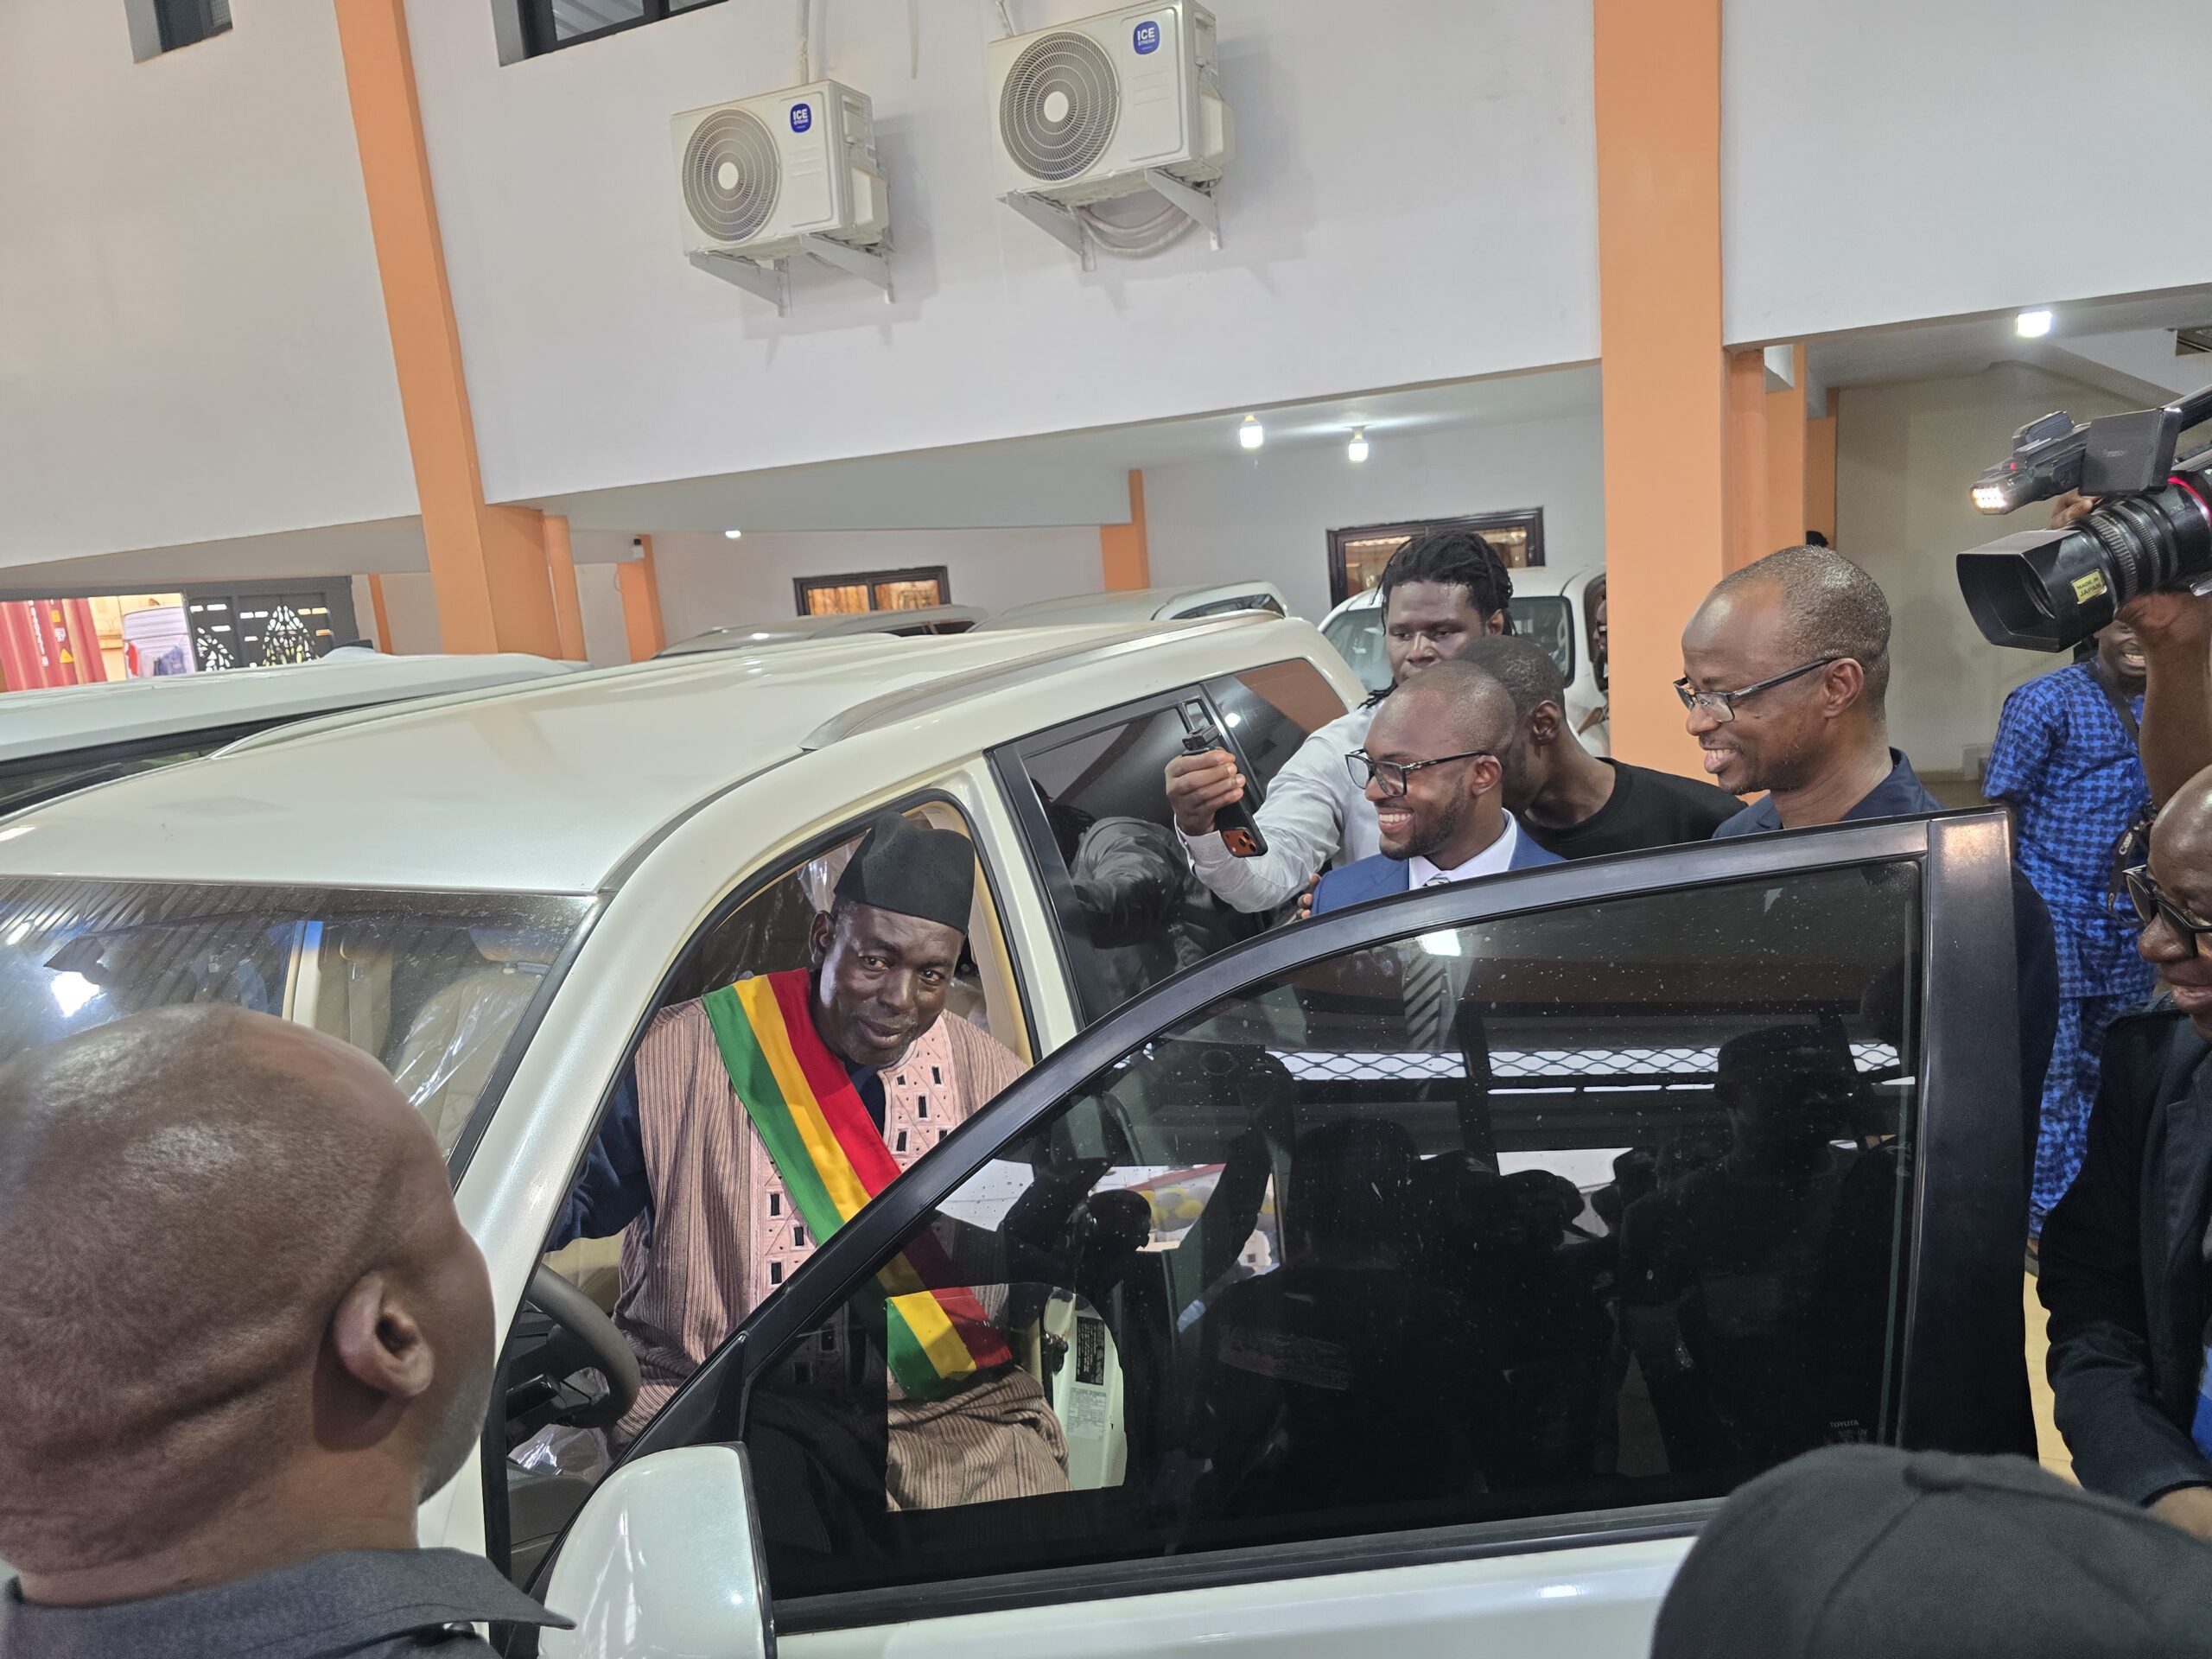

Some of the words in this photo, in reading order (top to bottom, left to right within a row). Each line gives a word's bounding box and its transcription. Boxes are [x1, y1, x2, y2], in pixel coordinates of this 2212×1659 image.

[1137, 27, 1155, 41] ICE
[792, 108, 808, 121] ICE
[2081, 582, 2102, 596] JAPAN
[1829, 1420, 1859, 1428] TOYOTA
